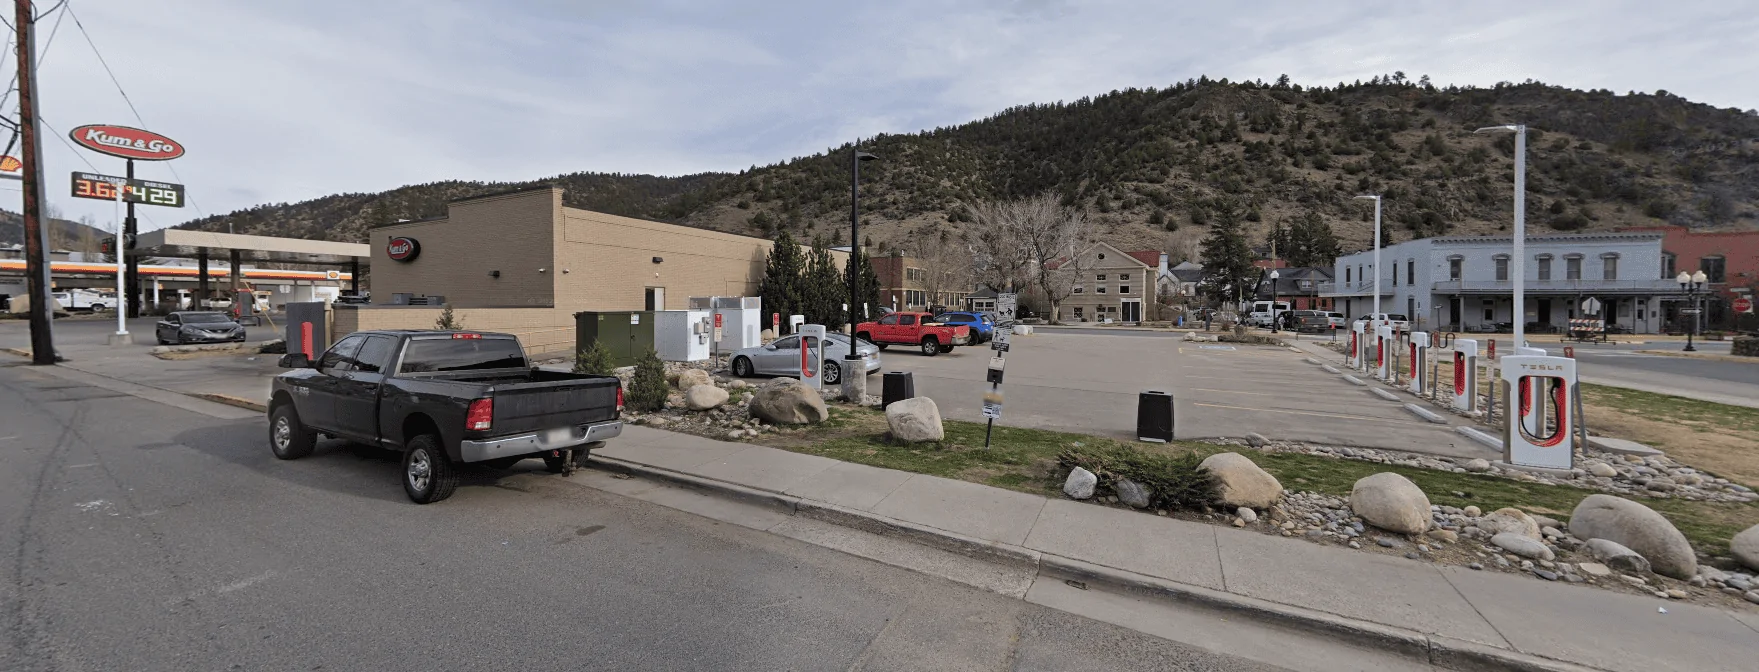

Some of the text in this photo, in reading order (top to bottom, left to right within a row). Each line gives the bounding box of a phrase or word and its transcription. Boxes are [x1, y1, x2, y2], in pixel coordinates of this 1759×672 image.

[86, 128, 174, 153] Kum & Go
[82, 173, 127, 186] UNLEADED
[144, 181, 173, 190] DIESEL
[1520, 363, 1563, 371] TESLA
